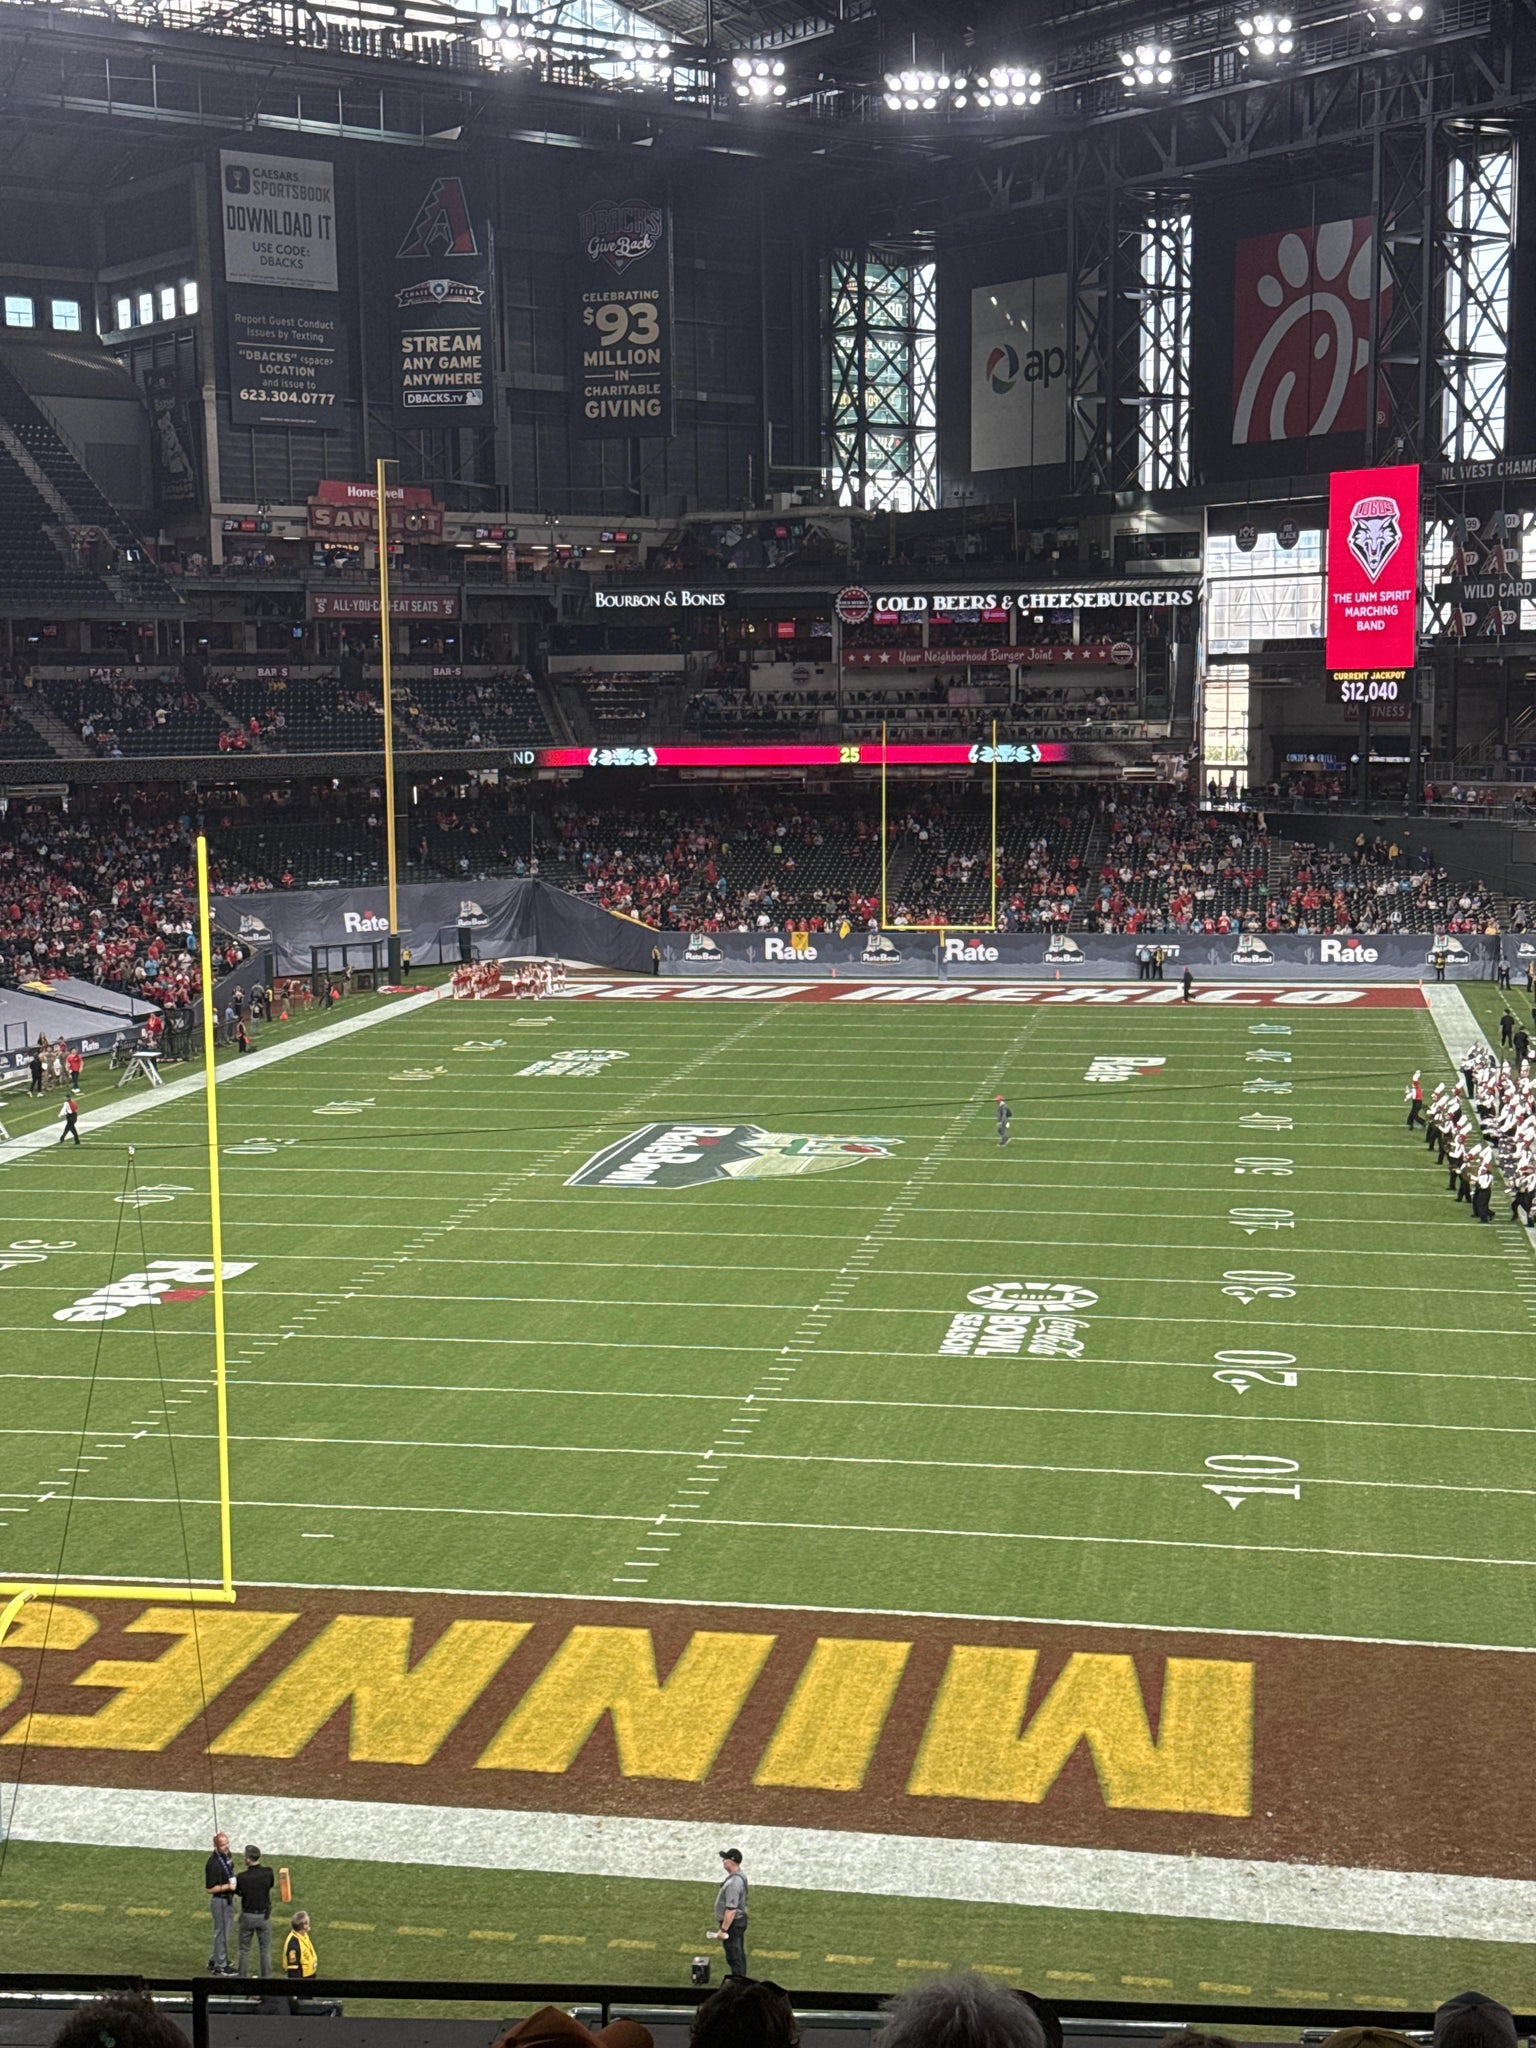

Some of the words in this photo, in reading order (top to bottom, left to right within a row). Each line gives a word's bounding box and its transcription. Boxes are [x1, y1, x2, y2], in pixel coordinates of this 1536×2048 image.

[253, 168, 298, 182] CAESARS
[253, 181, 331, 204] SPORTSBOOK
[226, 205, 312, 237] DOWNLOAD
[318, 215, 331, 240] IT
[252, 242, 274, 255] USE
[275, 243, 310, 256] CODE:
[587, 236, 617, 259] Give
[615, 233, 653, 257] Back
[260, 256, 304, 269] DBACKS
[583, 290, 659, 302] CELEBRATING
[235, 313, 266, 327] Report
[268, 316, 295, 327] Guest
[297, 318, 334, 330] Conduct
[583, 302, 660, 346] $93
[247, 327, 275, 338] Issues
[278, 328, 289, 340] by
[291, 330, 324, 343] Texting
[401, 335, 482, 352] STREAM
[403, 356, 435, 370] ANY
[438, 355, 482, 368] GAME
[584, 349, 660, 367] MILLION
[259, 364, 315, 377] LOCATION
[614, 370, 629, 381] IN
[262, 378, 280, 388] and
[281, 378, 304, 389] issue
[306, 380, 316, 389] to
[403, 373, 482, 386] ANYWHERE
[240, 389, 335, 406] 623.304.0777
[407, 392, 463, 404] DBACKS.TV
[584, 384, 661, 397] CHARITABLE
[585, 399, 662, 418] GIVING
[1442, 467, 1456, 481] NL
[1461, 463, 1493, 479] WEST
[347, 486, 404, 500] Honewell
[1466, 519, 1478, 529] 99
[1506, 516, 1516, 526] 01
[664, 591, 677, 606] &
[1333, 592, 1352, 604] THE
[1355, 592, 1377, 603] UNM
[1380, 590, 1411, 602] SPIRIT
[1464, 584, 1495, 599] WILD
[1499, 582, 1533, 597] CARD
[333, 600, 410, 613] ALL-YOU-C-EAT
[411, 601, 439, 613] SEATS
[876, 596, 928, 612] COLD
[932, 594, 997, 611] BEERS
[1002, 595, 1013, 610] &
[1017, 590, 1193, 609] CHEESEBURGERS
[1345, 605, 1398, 617] MARCHING
[1503, 612, 1514, 622] 23
[1357, 620, 1385, 631] BAND
[899, 650, 921, 664] Your
[924, 648, 987, 663] Neighborhood
[990, 649, 1024, 664] Burger
[1027, 647, 1053, 662] Joint
[433, 668, 461, 676] BAR-S
[1333, 672, 1368, 680] CURRENT
[1371, 671, 1406, 680] JACKPOT
[1341, 680, 1397, 702] $12,040
[512, 751, 535, 765] ND
[840, 747, 860, 763] 25
[344, 912, 388, 932] Rate
[764, 938, 818, 960] Rate
[945, 938, 999, 961] Rate
[1320, 939, 1378, 963] Rate
[830, 986, 1368, 1005] MEXICO
[82, 1039, 99, 1052] Rate
[1229, 1208, 1294, 1230] 40
[53, 1260, 259, 1322] Rate
[1221, 1270, 1296, 1299] 30
[938, 1313, 984, 1355] SEASON
[974, 1315, 1032, 1356] BOWL
[1212, 1350, 1298, 1386] 20
[1202, 1454, 1300, 1500] 10
